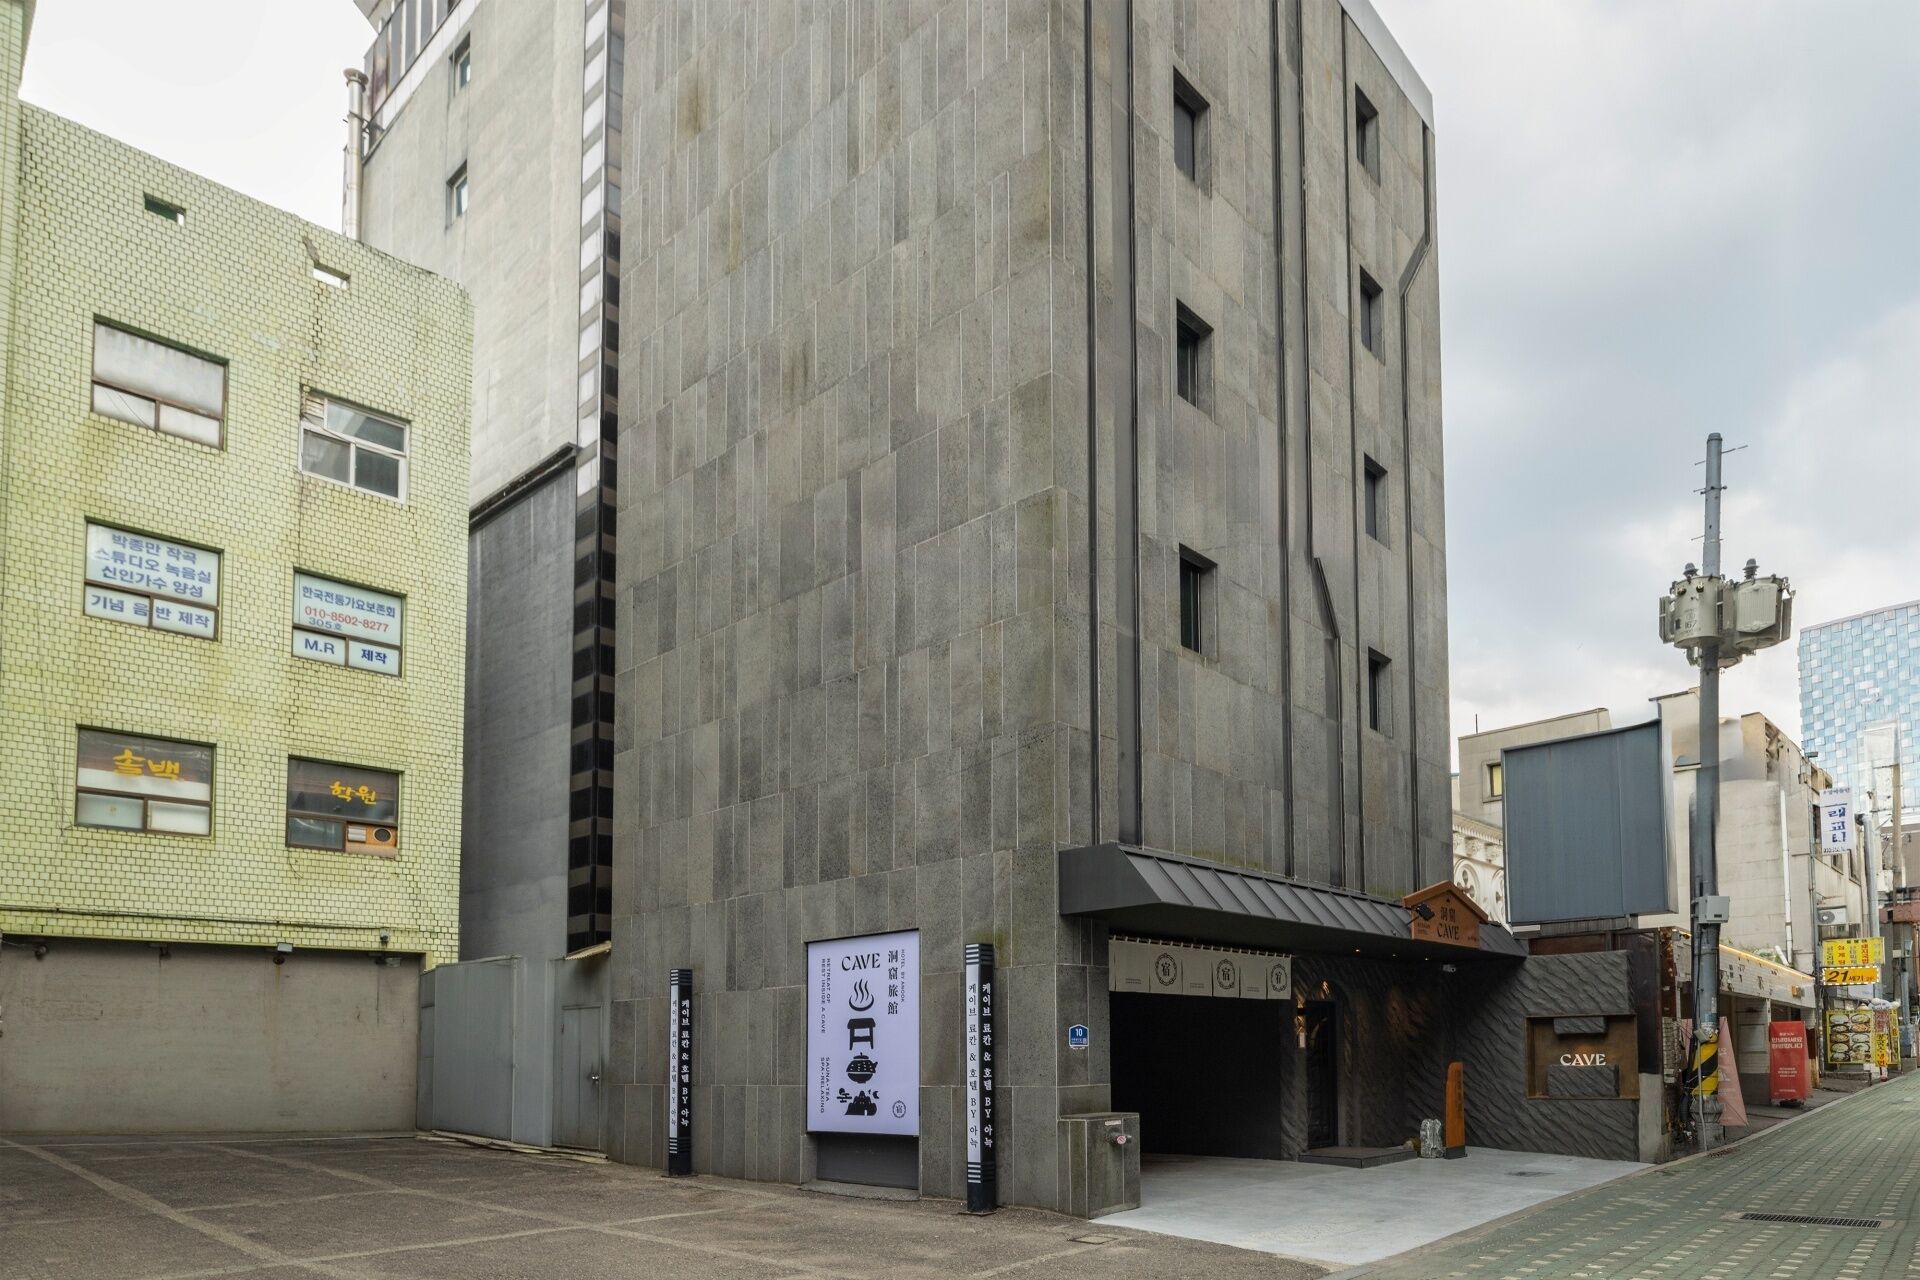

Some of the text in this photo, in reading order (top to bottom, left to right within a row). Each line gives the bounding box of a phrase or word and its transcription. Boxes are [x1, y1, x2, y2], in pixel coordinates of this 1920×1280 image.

[112, 534, 198, 565] 박종만 작곡
[94, 547, 211, 584] 스튜디오 녹음실
[102, 565, 203, 598] 신인가수 양성
[91, 594, 124, 613] 기념
[178, 611, 210, 628] 제작
[302, 586, 396, 618] 한국전통가요보존회
[304, 606, 389, 633] 010-8502-8277
[308, 617, 342, 631] 305호
[304, 638, 387, 664] M.R 제작
[329, 781, 377, 805] 학원
[1437, 922, 1460, 941] CAVE
[841, 953, 881, 971] CAVE
[681, 999, 690, 1026] 케이브
[681, 1030, 690, 1049] 료칸
[1075, 1028, 1083, 1037] 10
[681, 1052, 689, 1060] &
[968, 983, 978, 1148] 케이브 료칸 & 호텔 BY 아늑
[982, 982, 993, 1148] 케이브 료칸 & 호텔 BY 아늑
[1560, 1053, 1607, 1066] CAVE
[681, 1065, 690, 1083] 호텔
